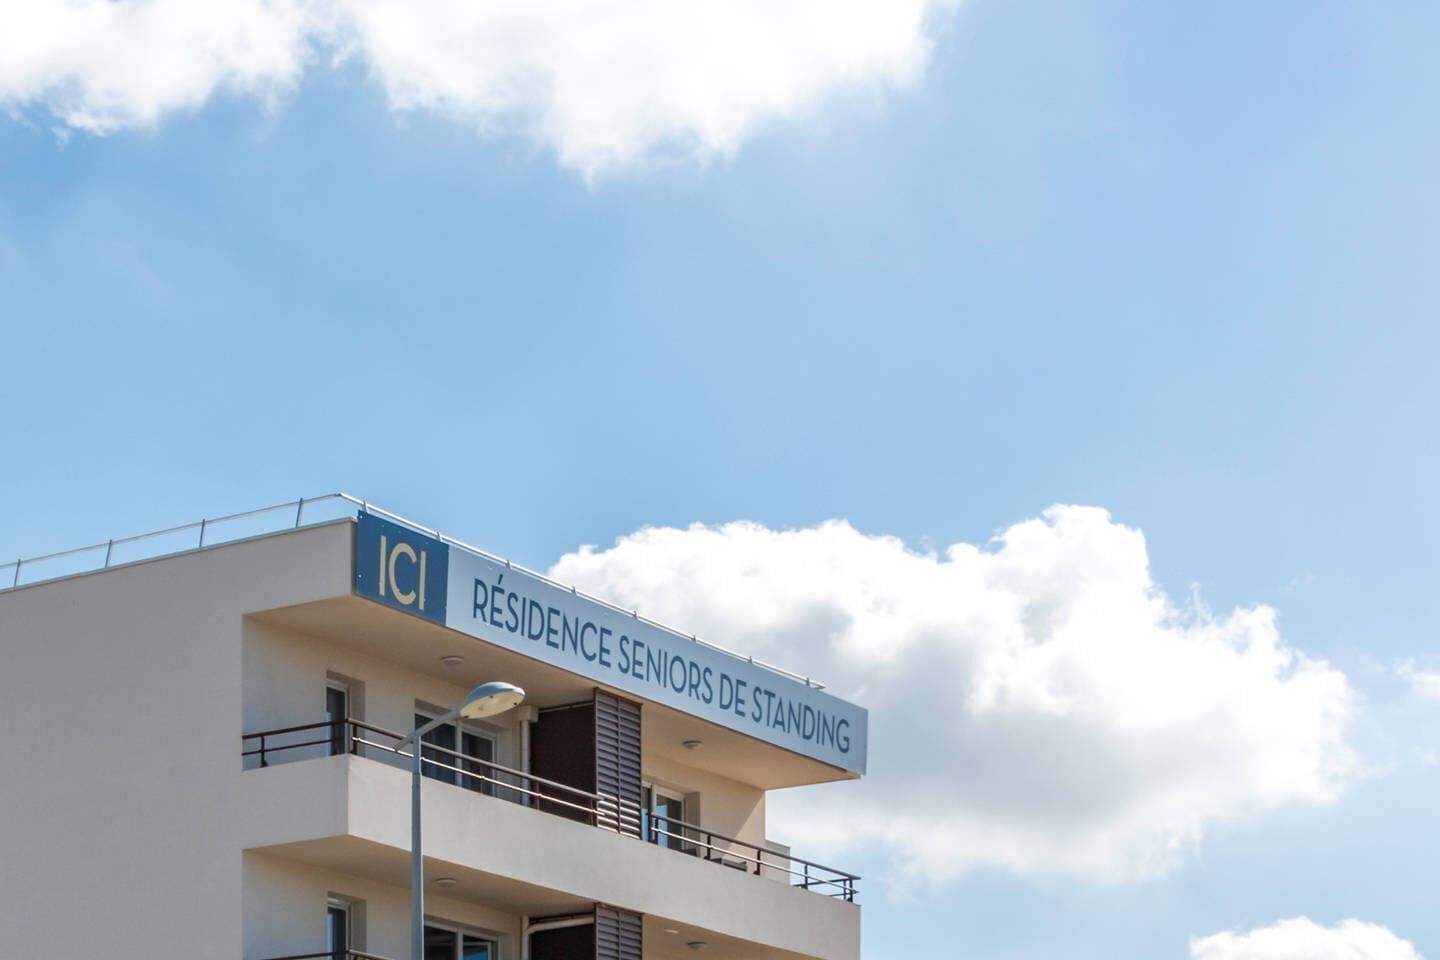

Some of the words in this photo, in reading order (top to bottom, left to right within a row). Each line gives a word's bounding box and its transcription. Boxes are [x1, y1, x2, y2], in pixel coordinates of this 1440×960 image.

[379, 535, 426, 610] ICI
[473, 574, 611, 669] RÉSIDENCE
[618, 635, 714, 706] SENIORS
[720, 671, 748, 717] DE
[751, 685, 850, 755] STANDING
